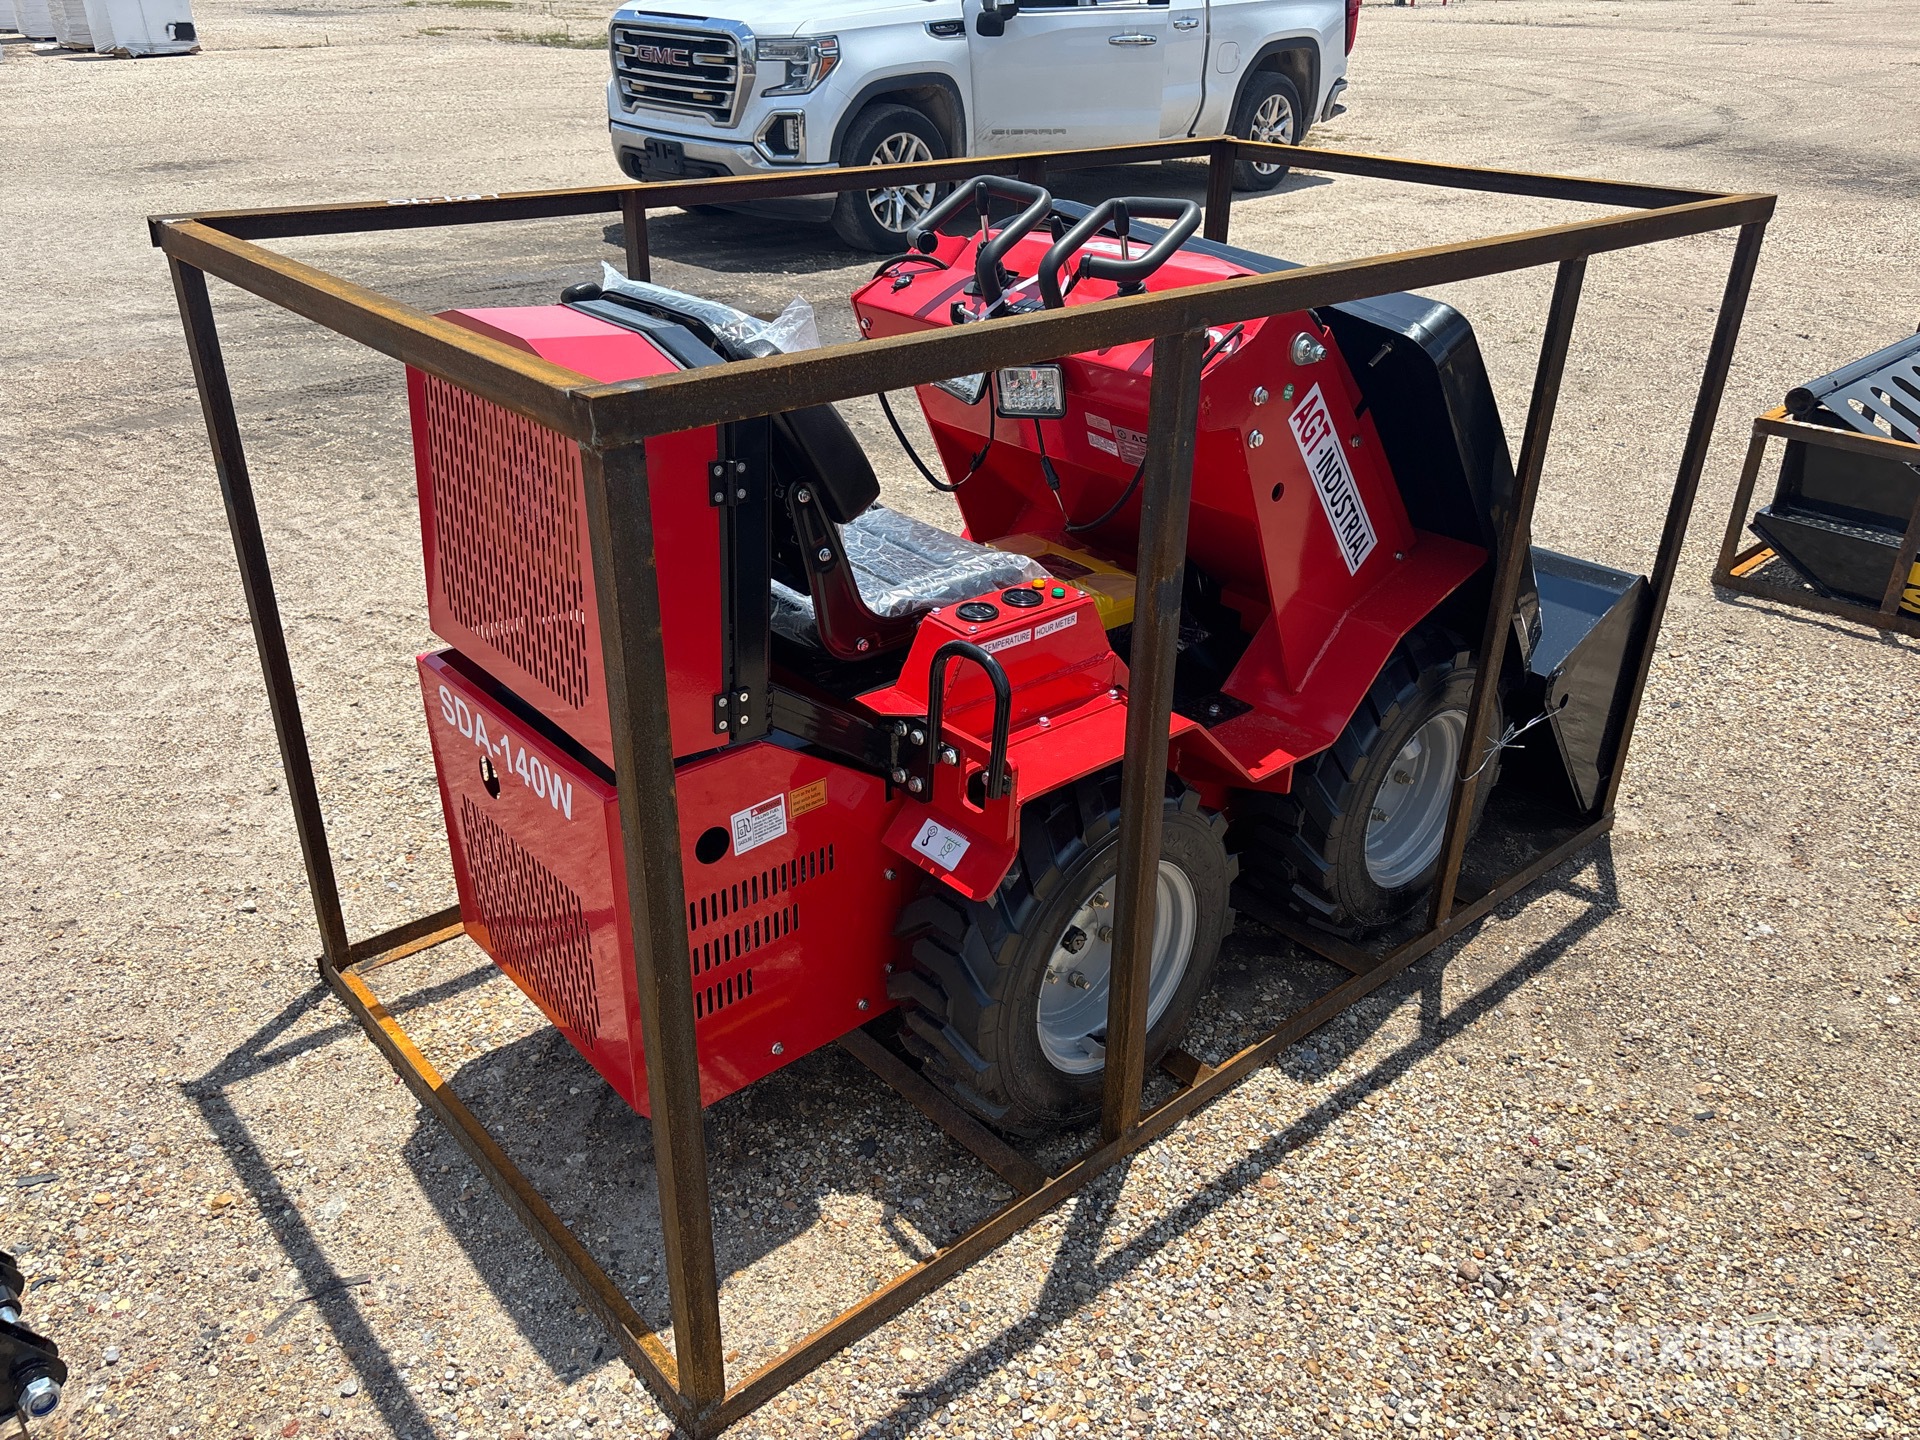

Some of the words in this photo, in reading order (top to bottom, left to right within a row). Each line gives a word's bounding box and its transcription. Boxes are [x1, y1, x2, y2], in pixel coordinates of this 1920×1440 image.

[637, 44, 690, 67] GMC
[990, 127, 1067, 135] SIERRA
[1132, 434, 1148, 444] AG
[1292, 394, 1331, 456] AGT
[1316, 446, 1370, 566] INDUSTRIAL
[1036, 621, 1055, 636] HOUR
[1055, 613, 1076, 631] METER
[983, 630, 1031, 652] TEMPERATURE
[438, 684, 573, 821] SDA-140W
[759, 800, 780, 812] WARNING
[755, 812, 770, 821] FILLING
[738, 836, 752, 846] GASOLINE
